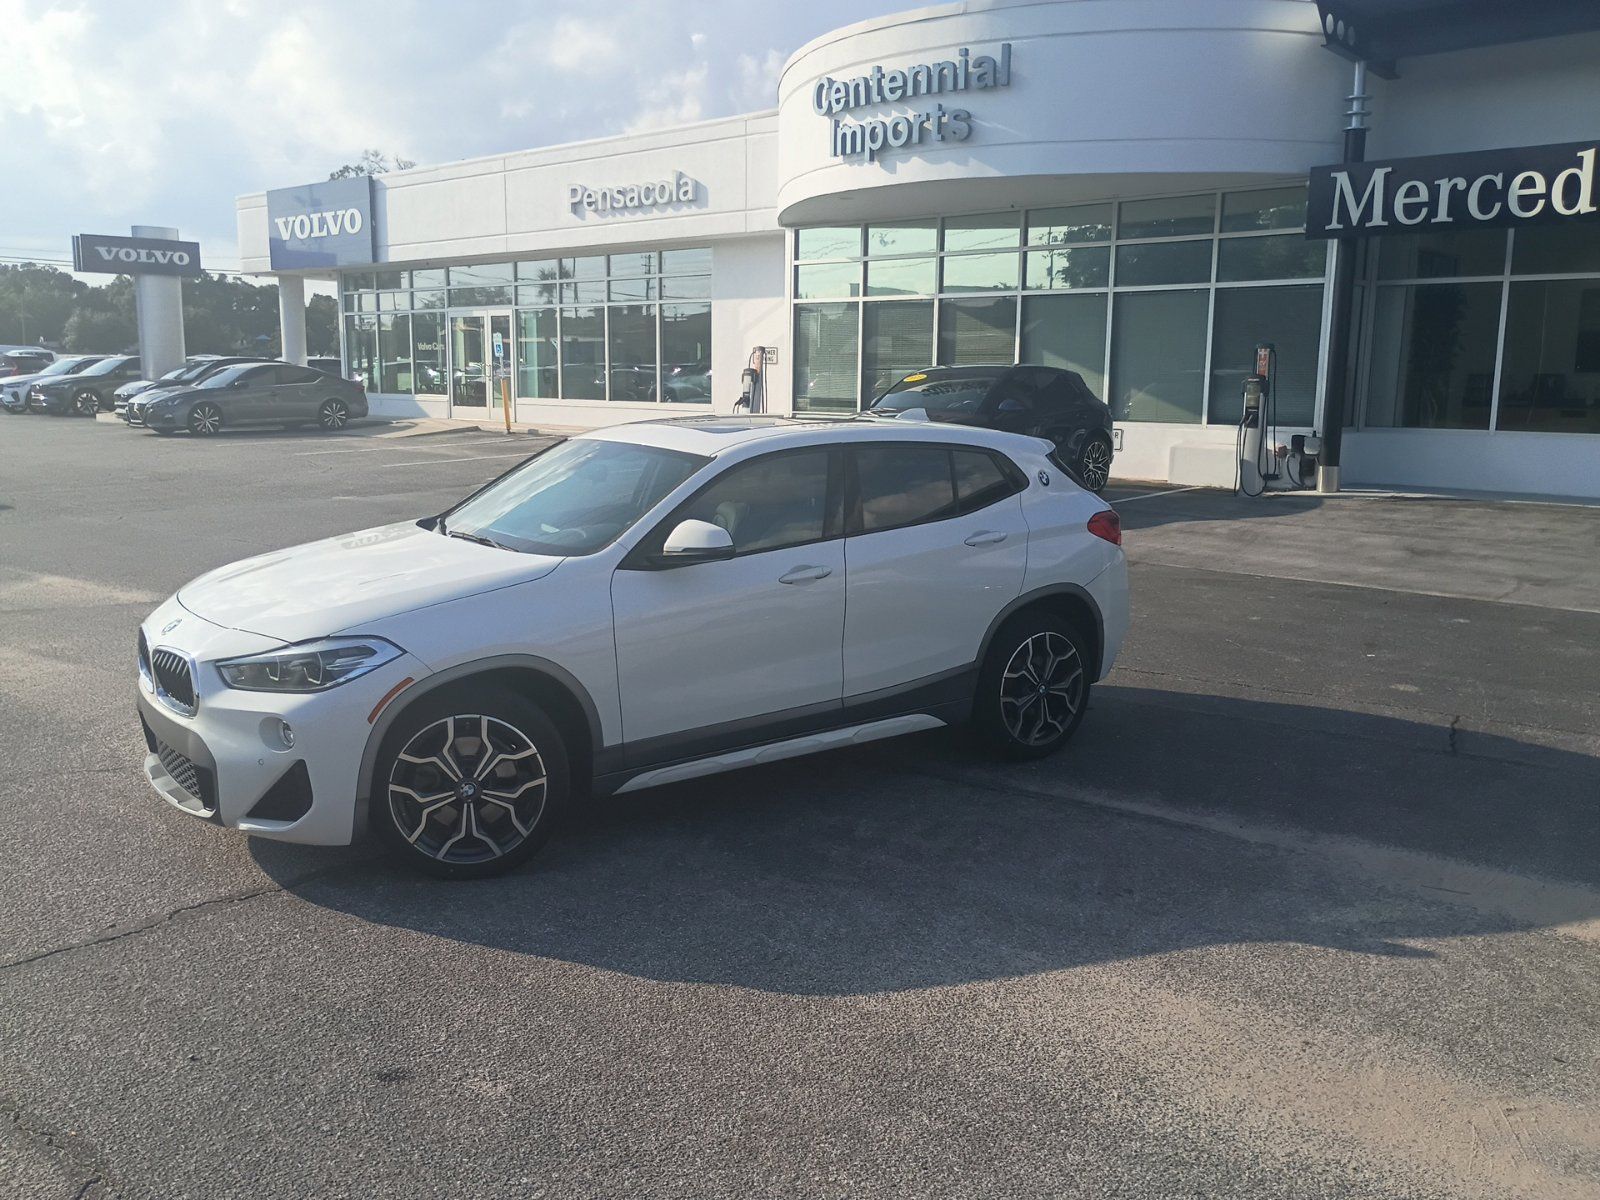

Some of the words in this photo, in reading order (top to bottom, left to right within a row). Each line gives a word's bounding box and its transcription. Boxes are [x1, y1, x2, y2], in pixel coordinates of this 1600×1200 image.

[813, 42, 1012, 116] Centennial
[830, 103, 972, 162] Imports
[567, 170, 698, 214] Pensacola
[1325, 147, 1598, 231] Merced
[275, 208, 363, 242] VOLVO
[94, 245, 190, 266] VOLVO
